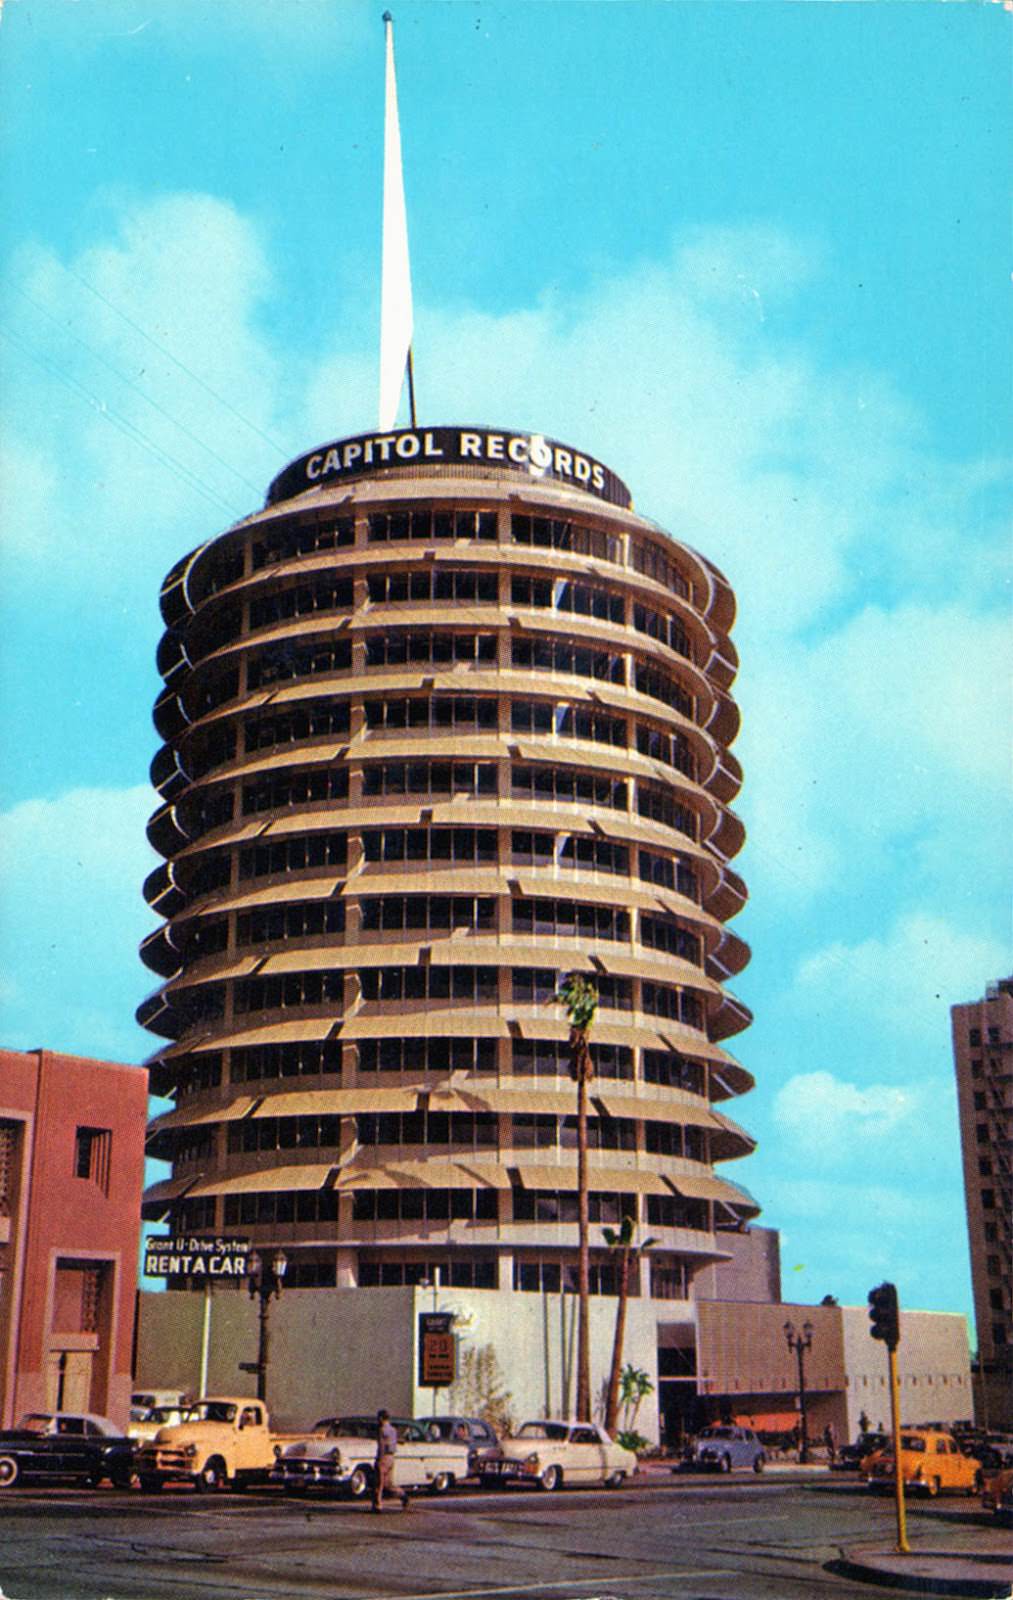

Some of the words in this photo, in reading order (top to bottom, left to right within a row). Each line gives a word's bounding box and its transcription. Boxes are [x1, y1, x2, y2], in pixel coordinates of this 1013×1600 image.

[306, 432, 443, 480] CAPITOL
[459, 431, 605, 490] RECORDS
[146, 1255, 192, 1274] RENT
[192, 1256, 206, 1274] A
[208, 1256, 246, 1275] CAR
